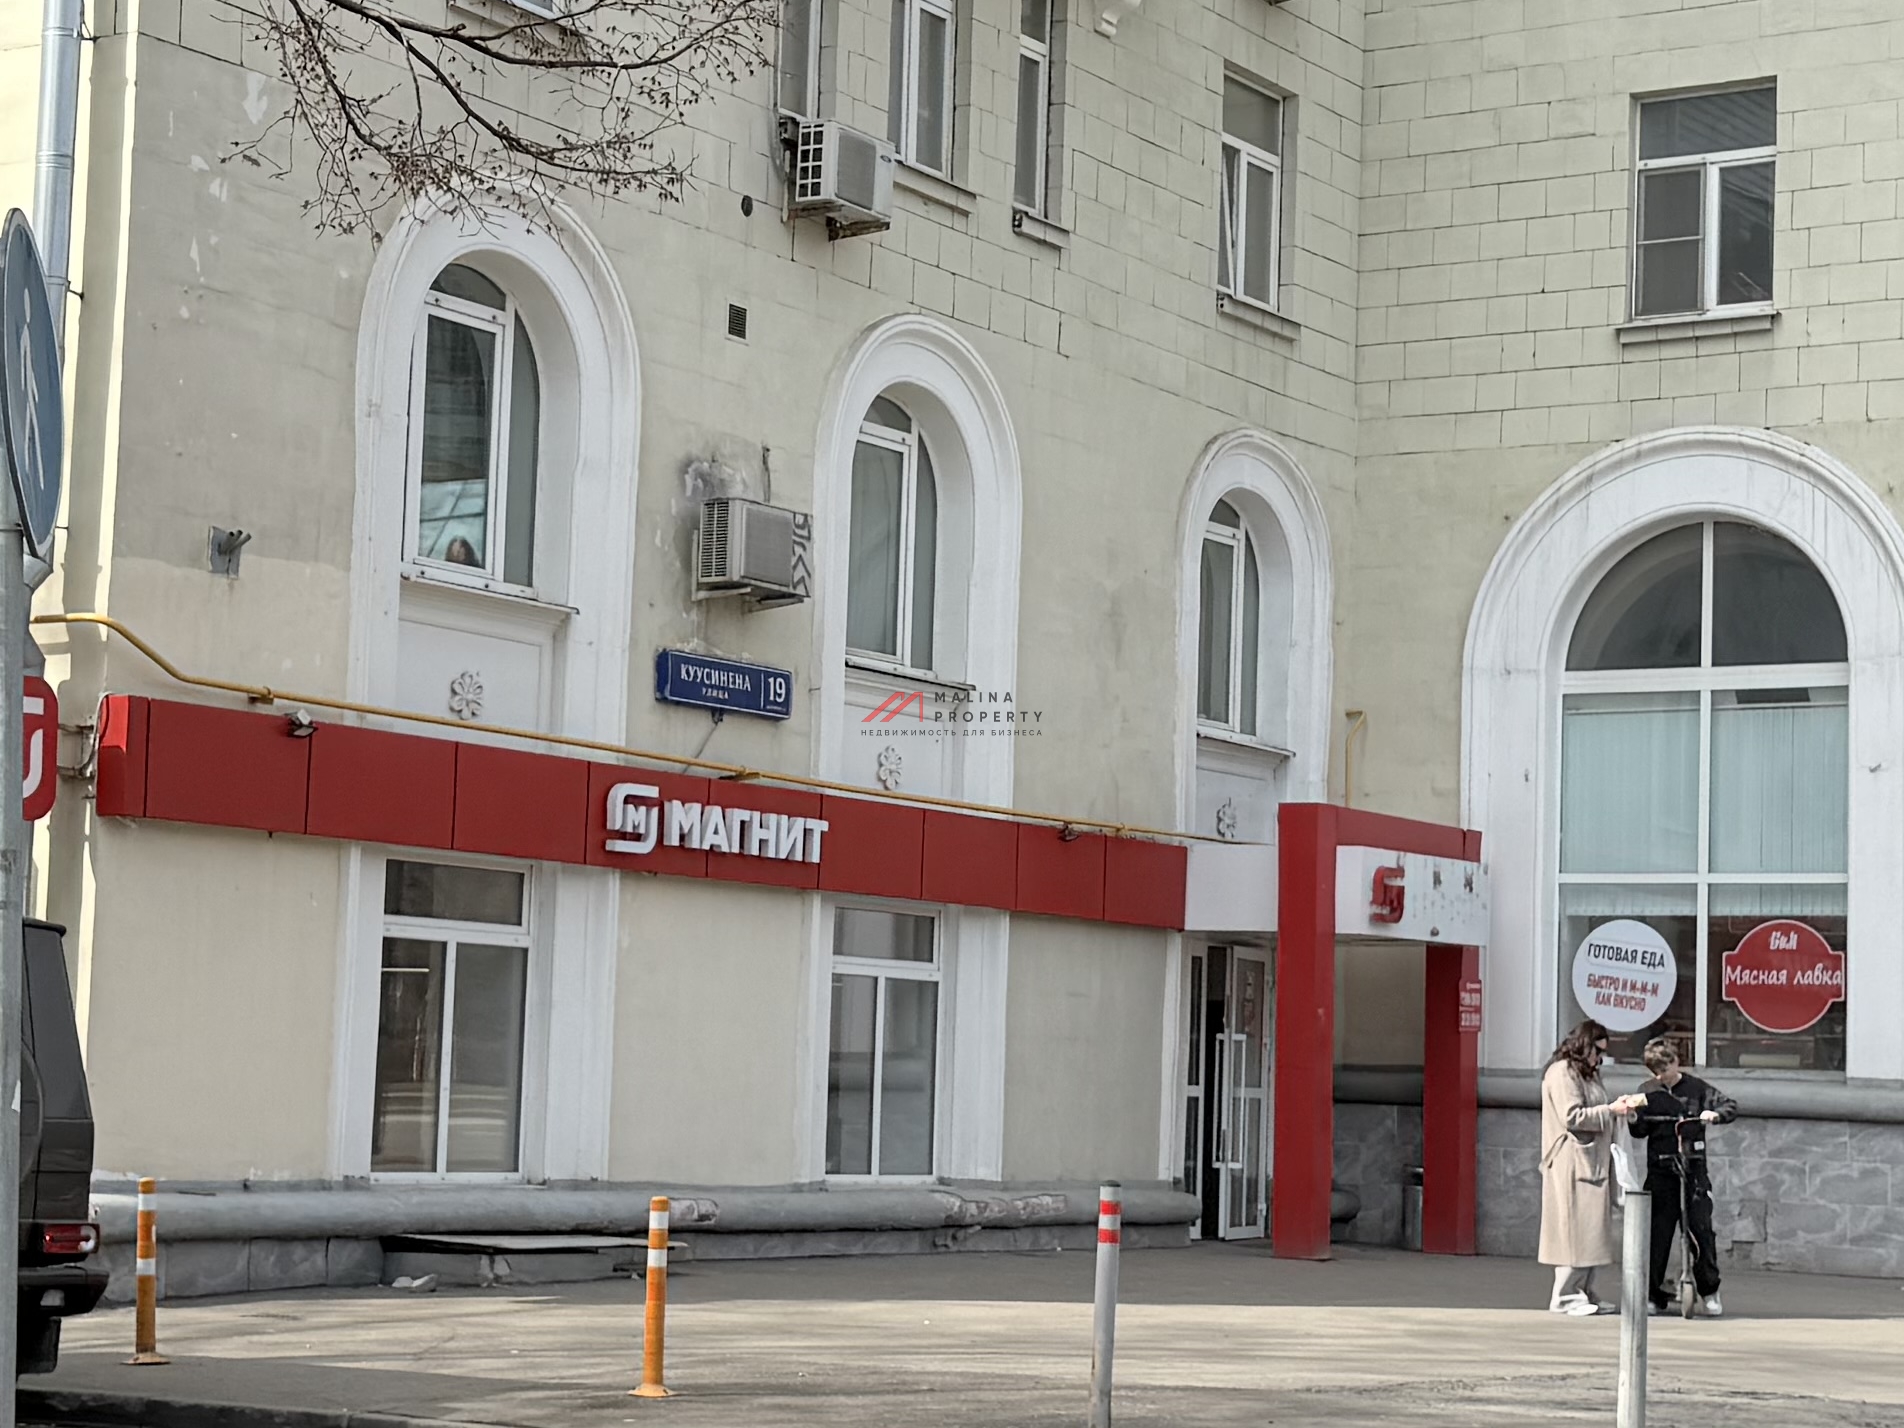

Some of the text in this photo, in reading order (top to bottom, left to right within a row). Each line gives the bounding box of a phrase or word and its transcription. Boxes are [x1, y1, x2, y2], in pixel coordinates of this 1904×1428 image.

[680, 663, 752, 692] КУУСИНЕНА
[768, 676, 786, 703] 19
[702, 687, 729, 700] УЛИЦА
[663, 799, 829, 864] МАГНИТ
[1587, 943, 1665, 969] ГОТОВАЯ ЕДА
[1587, 973, 1620, 992] БЫСТРО
[1621, 978, 1628, 993] И
[1725, 963, 1842, 985] Мясная лавка
[1595, 991, 1646, 1012] КАК ВКУСНО
